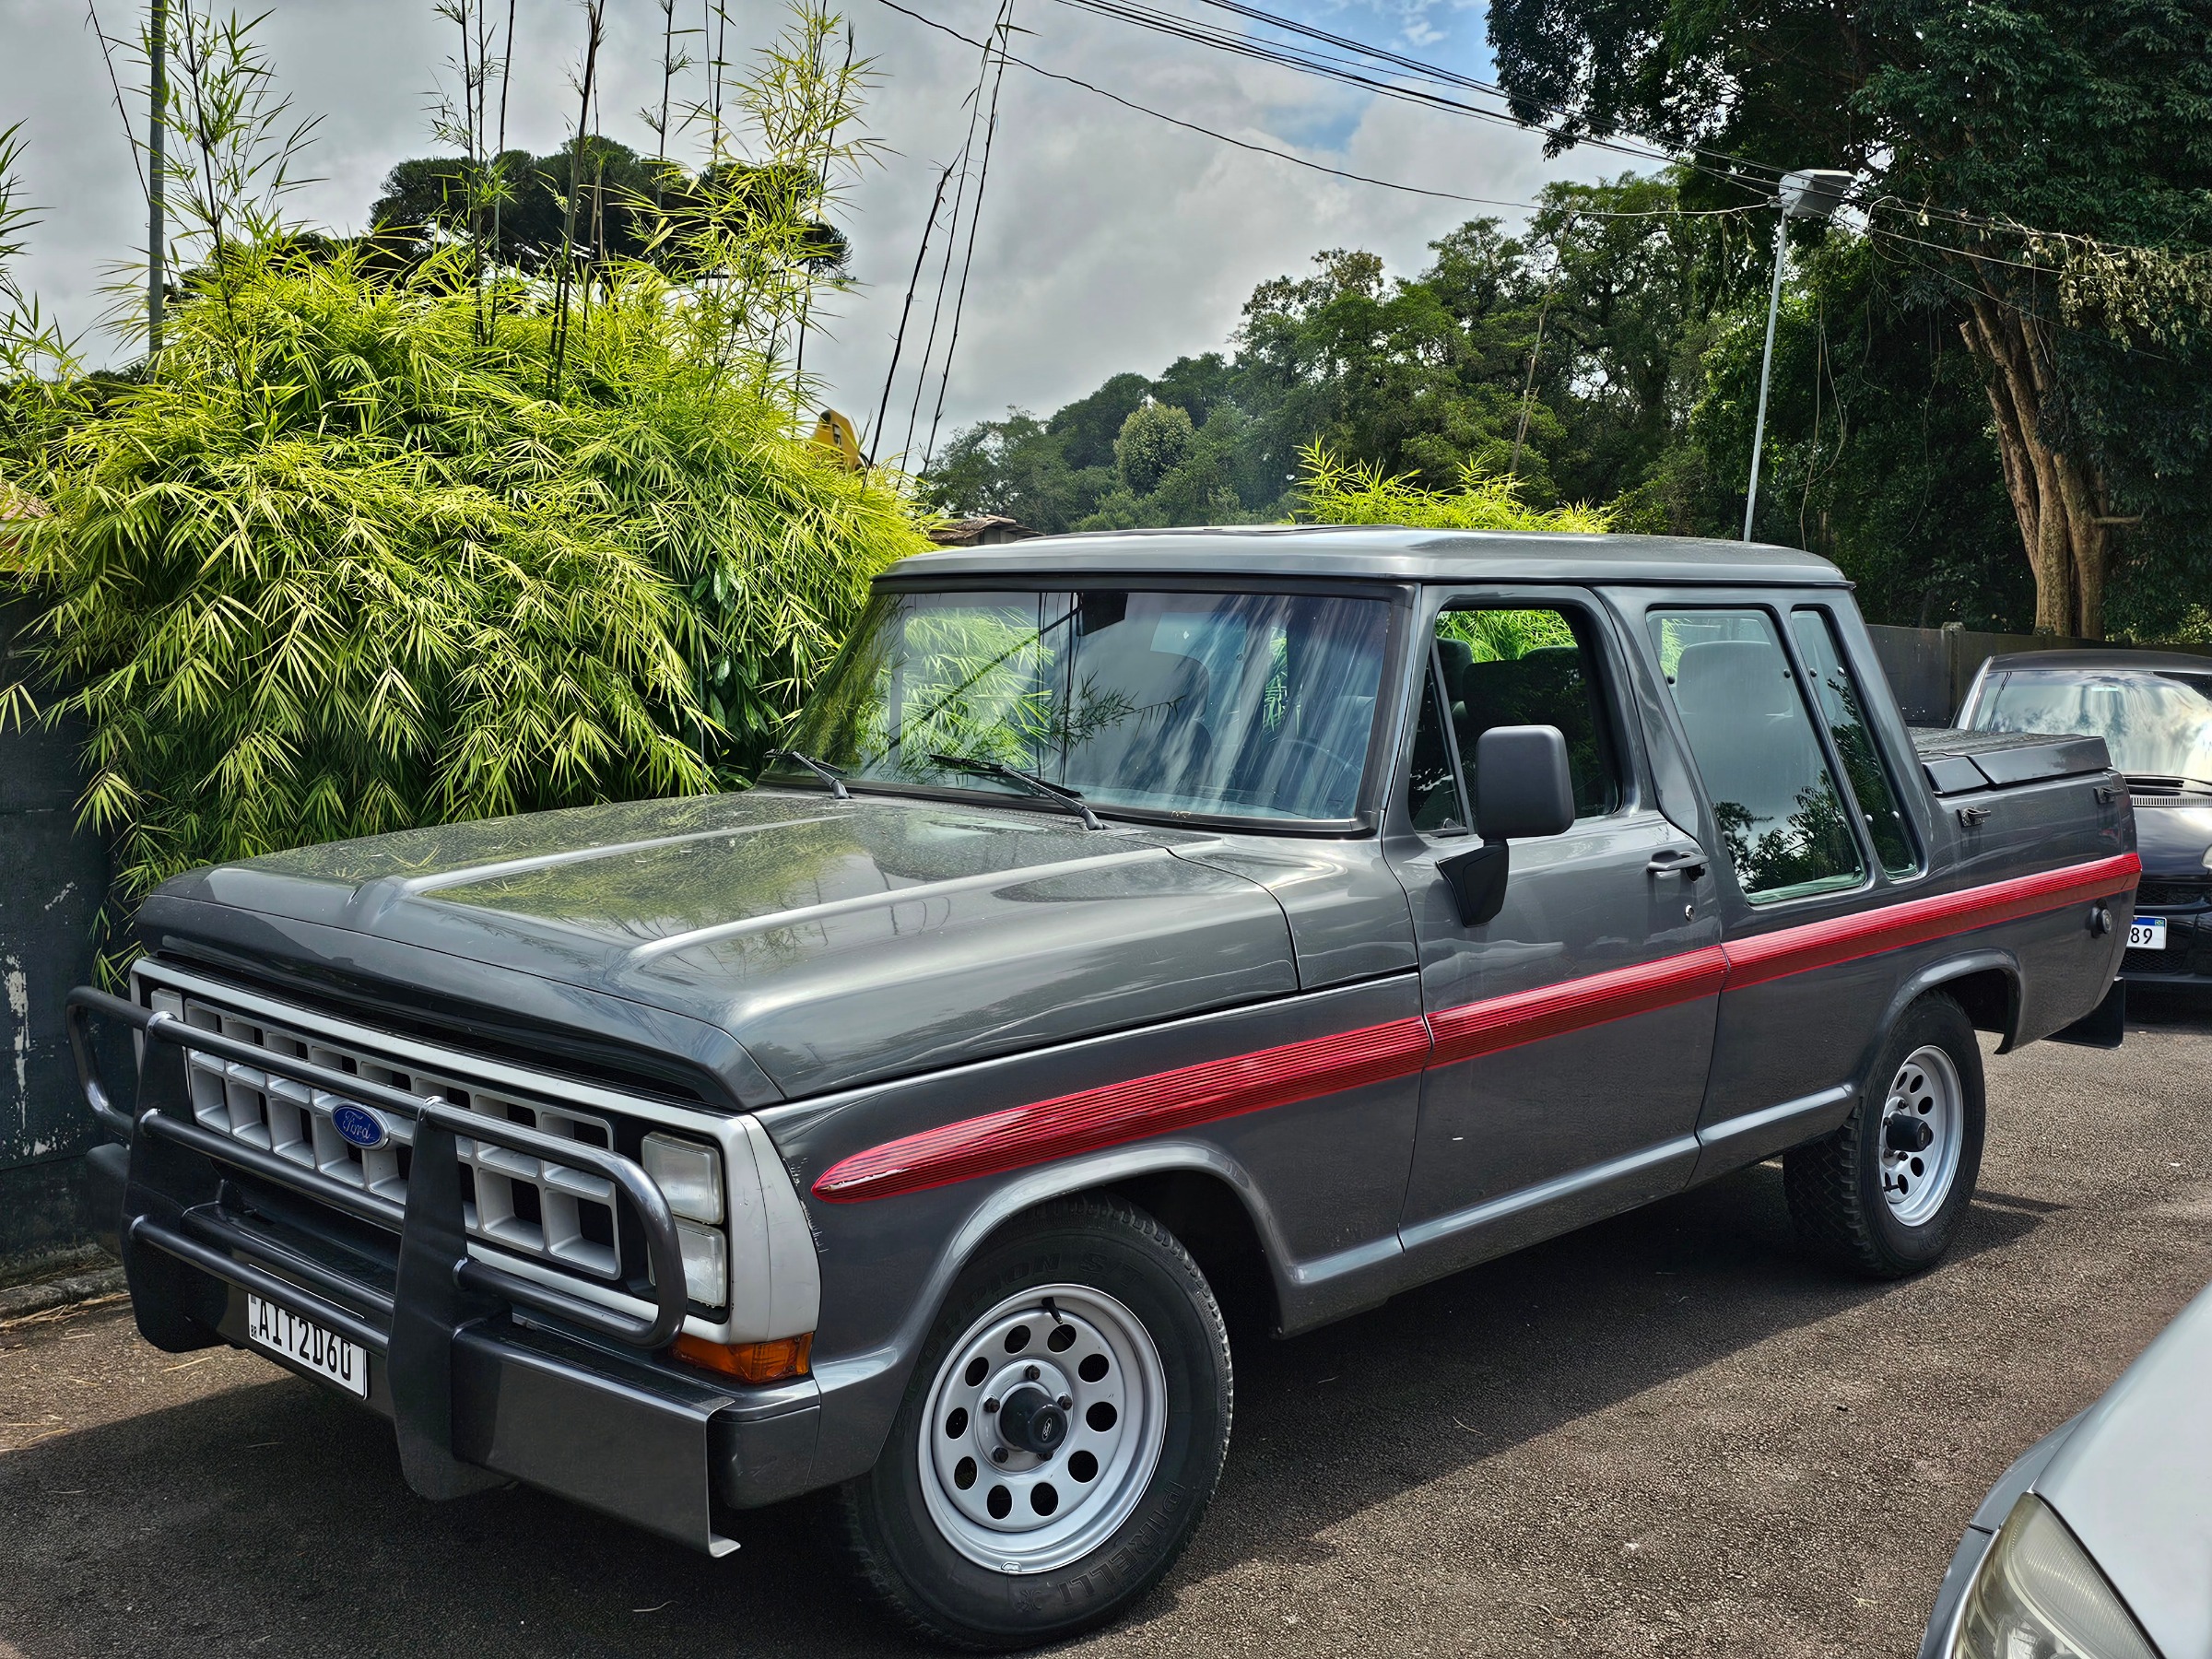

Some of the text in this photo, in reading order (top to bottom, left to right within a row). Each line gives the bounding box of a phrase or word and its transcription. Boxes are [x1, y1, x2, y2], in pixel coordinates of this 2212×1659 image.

[2130, 926, 2153, 945] 89
[342, 1110, 374, 1141] Ford
[259, 1299, 352, 1382] AIT2D60
[1056, 1479, 1186, 1606] PIRELLI
